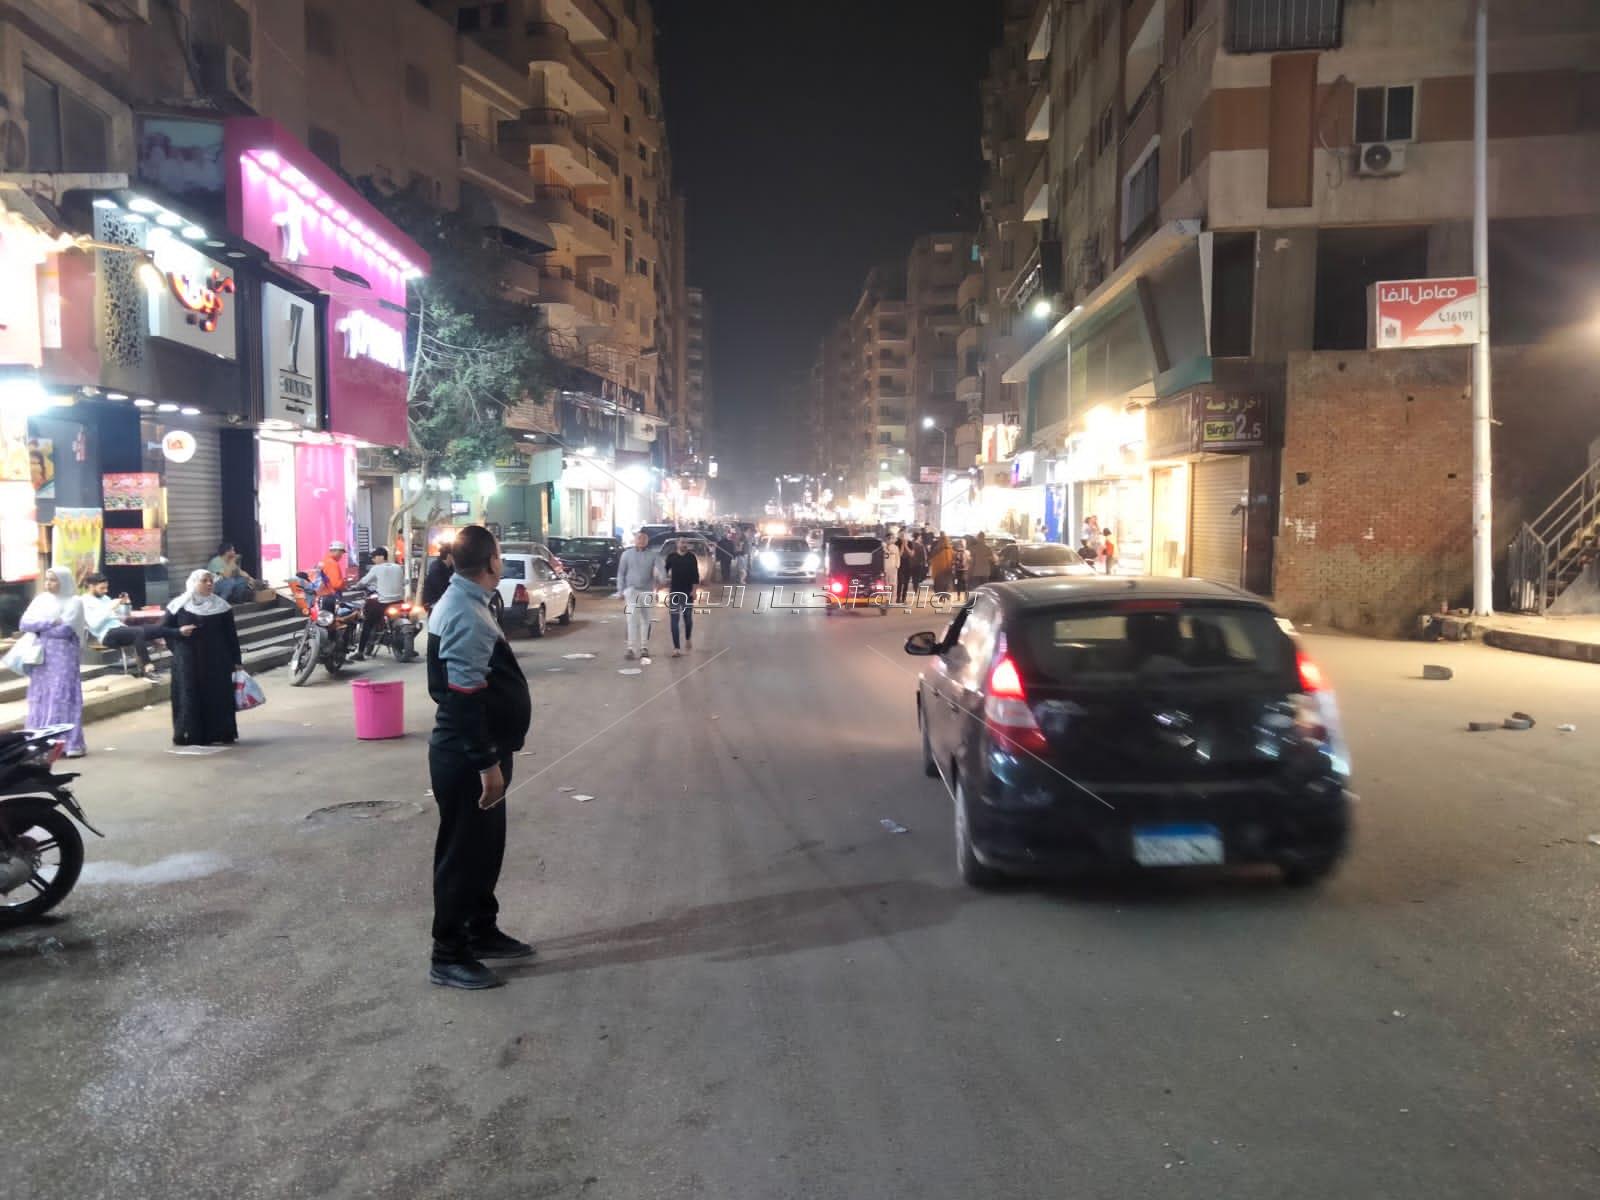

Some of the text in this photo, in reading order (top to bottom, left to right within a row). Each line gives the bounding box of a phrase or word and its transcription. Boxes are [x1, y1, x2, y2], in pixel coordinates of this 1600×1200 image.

[1381, 284, 1458, 305] معامل الفا
[1446, 310, 1474, 322] 16191
